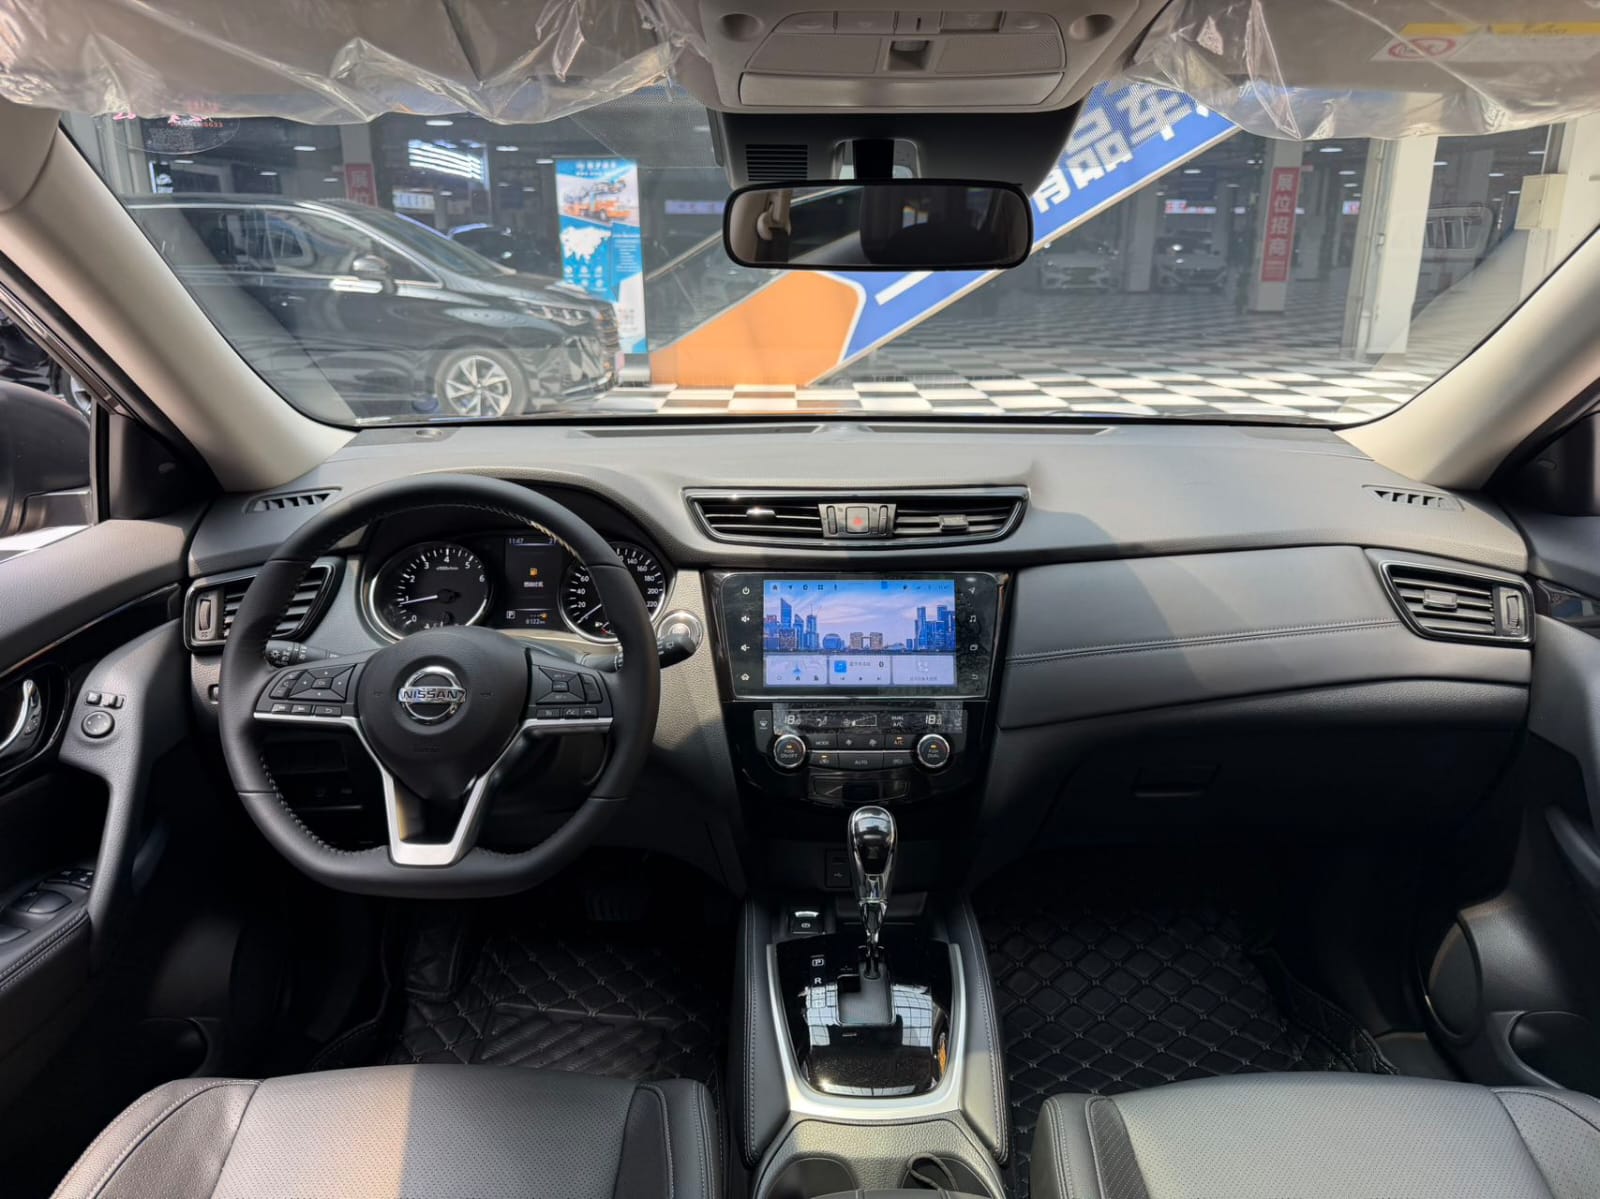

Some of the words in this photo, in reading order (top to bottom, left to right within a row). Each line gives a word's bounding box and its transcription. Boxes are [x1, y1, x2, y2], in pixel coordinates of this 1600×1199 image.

[1031, 83, 1209, 213] 品车
[423, 562, 430, 570] 3
[464, 561, 471, 569] 5
[409, 575, 416, 583] 2
[479, 574, 486, 582] 6
[580, 575, 590, 583] 60
[411, 614, 417, 622] 0
[403, 689, 458, 699] NISSAN
